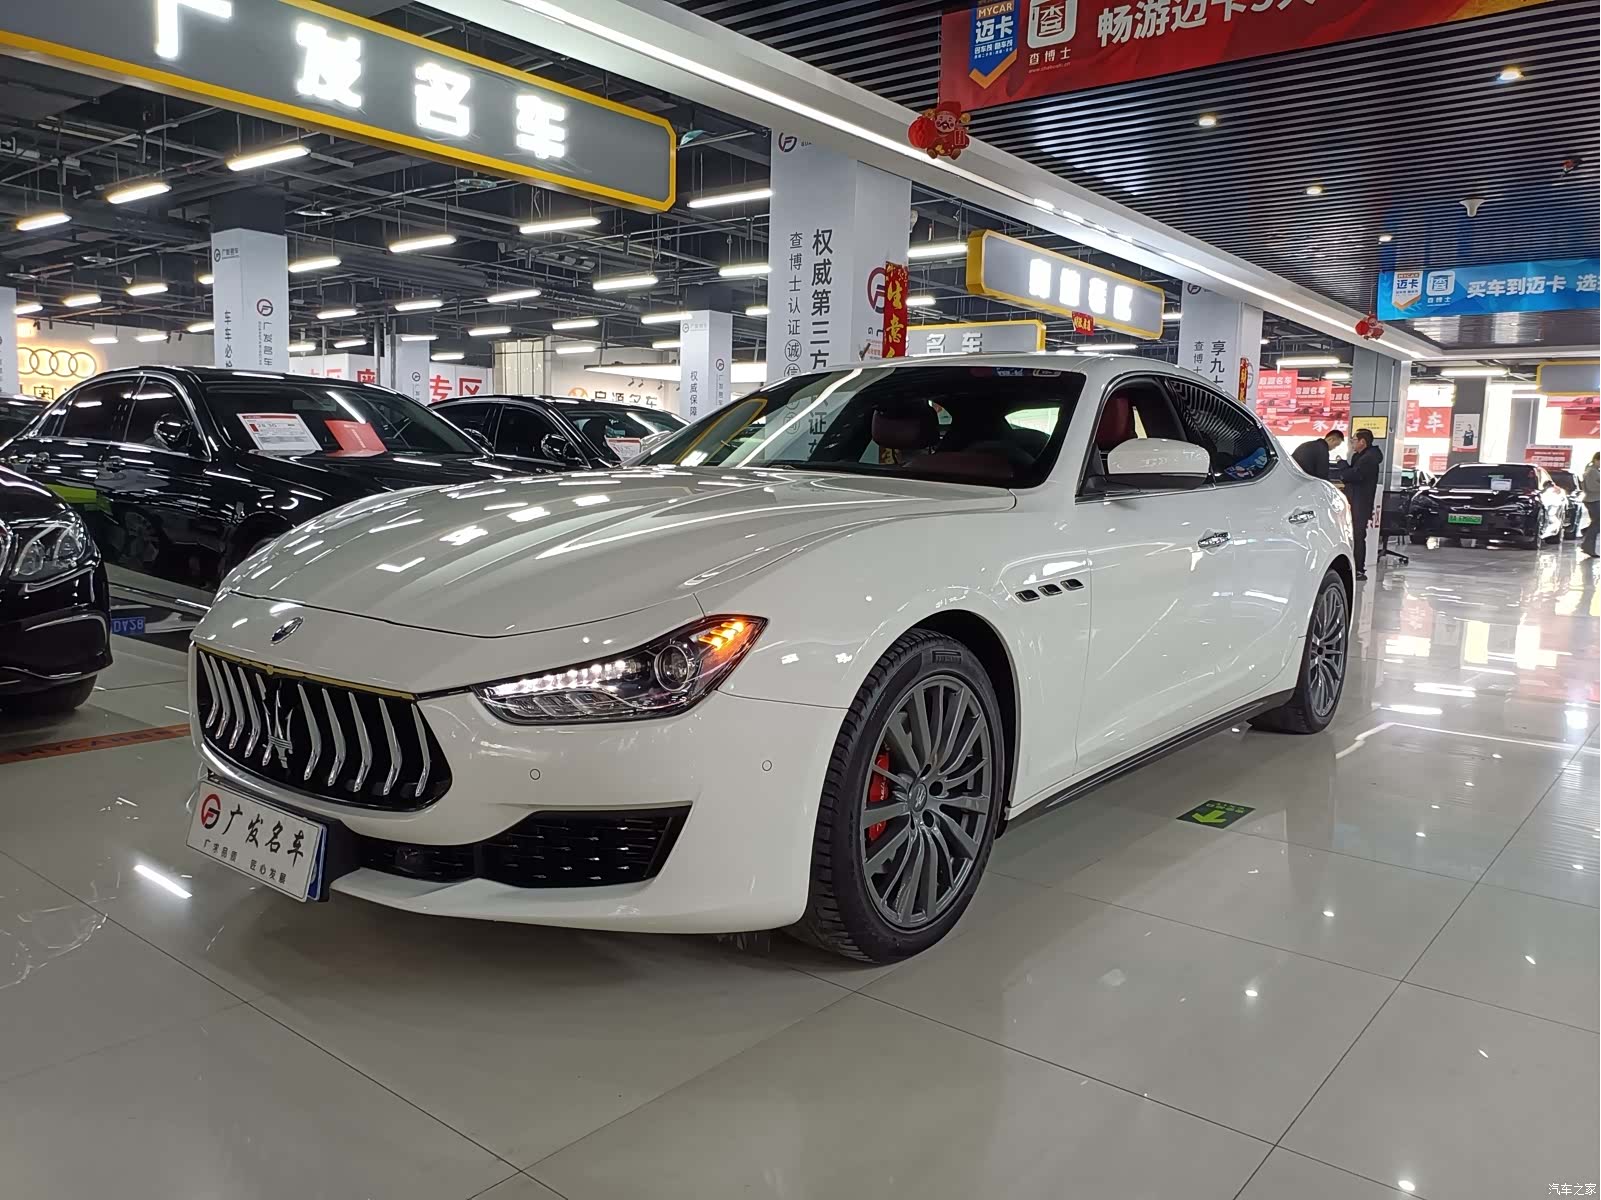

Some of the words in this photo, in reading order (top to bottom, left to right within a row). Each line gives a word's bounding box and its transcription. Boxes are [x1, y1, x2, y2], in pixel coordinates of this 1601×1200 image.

[978, 2, 1013, 18] MYCAR
[975, 15, 1014, 44] 迈卡
[1029, 47, 1071, 66] 查博士
[1396, 279, 1418, 290] 迈卡
[1466, 275, 1567, 298] 买车到迈卡
[1576, 274, 1600, 292] 选
[810, 228, 833, 370] 权威第三方
[690, 370, 698, 416] 权威保障
[222, 804, 304, 868] 广发名车
